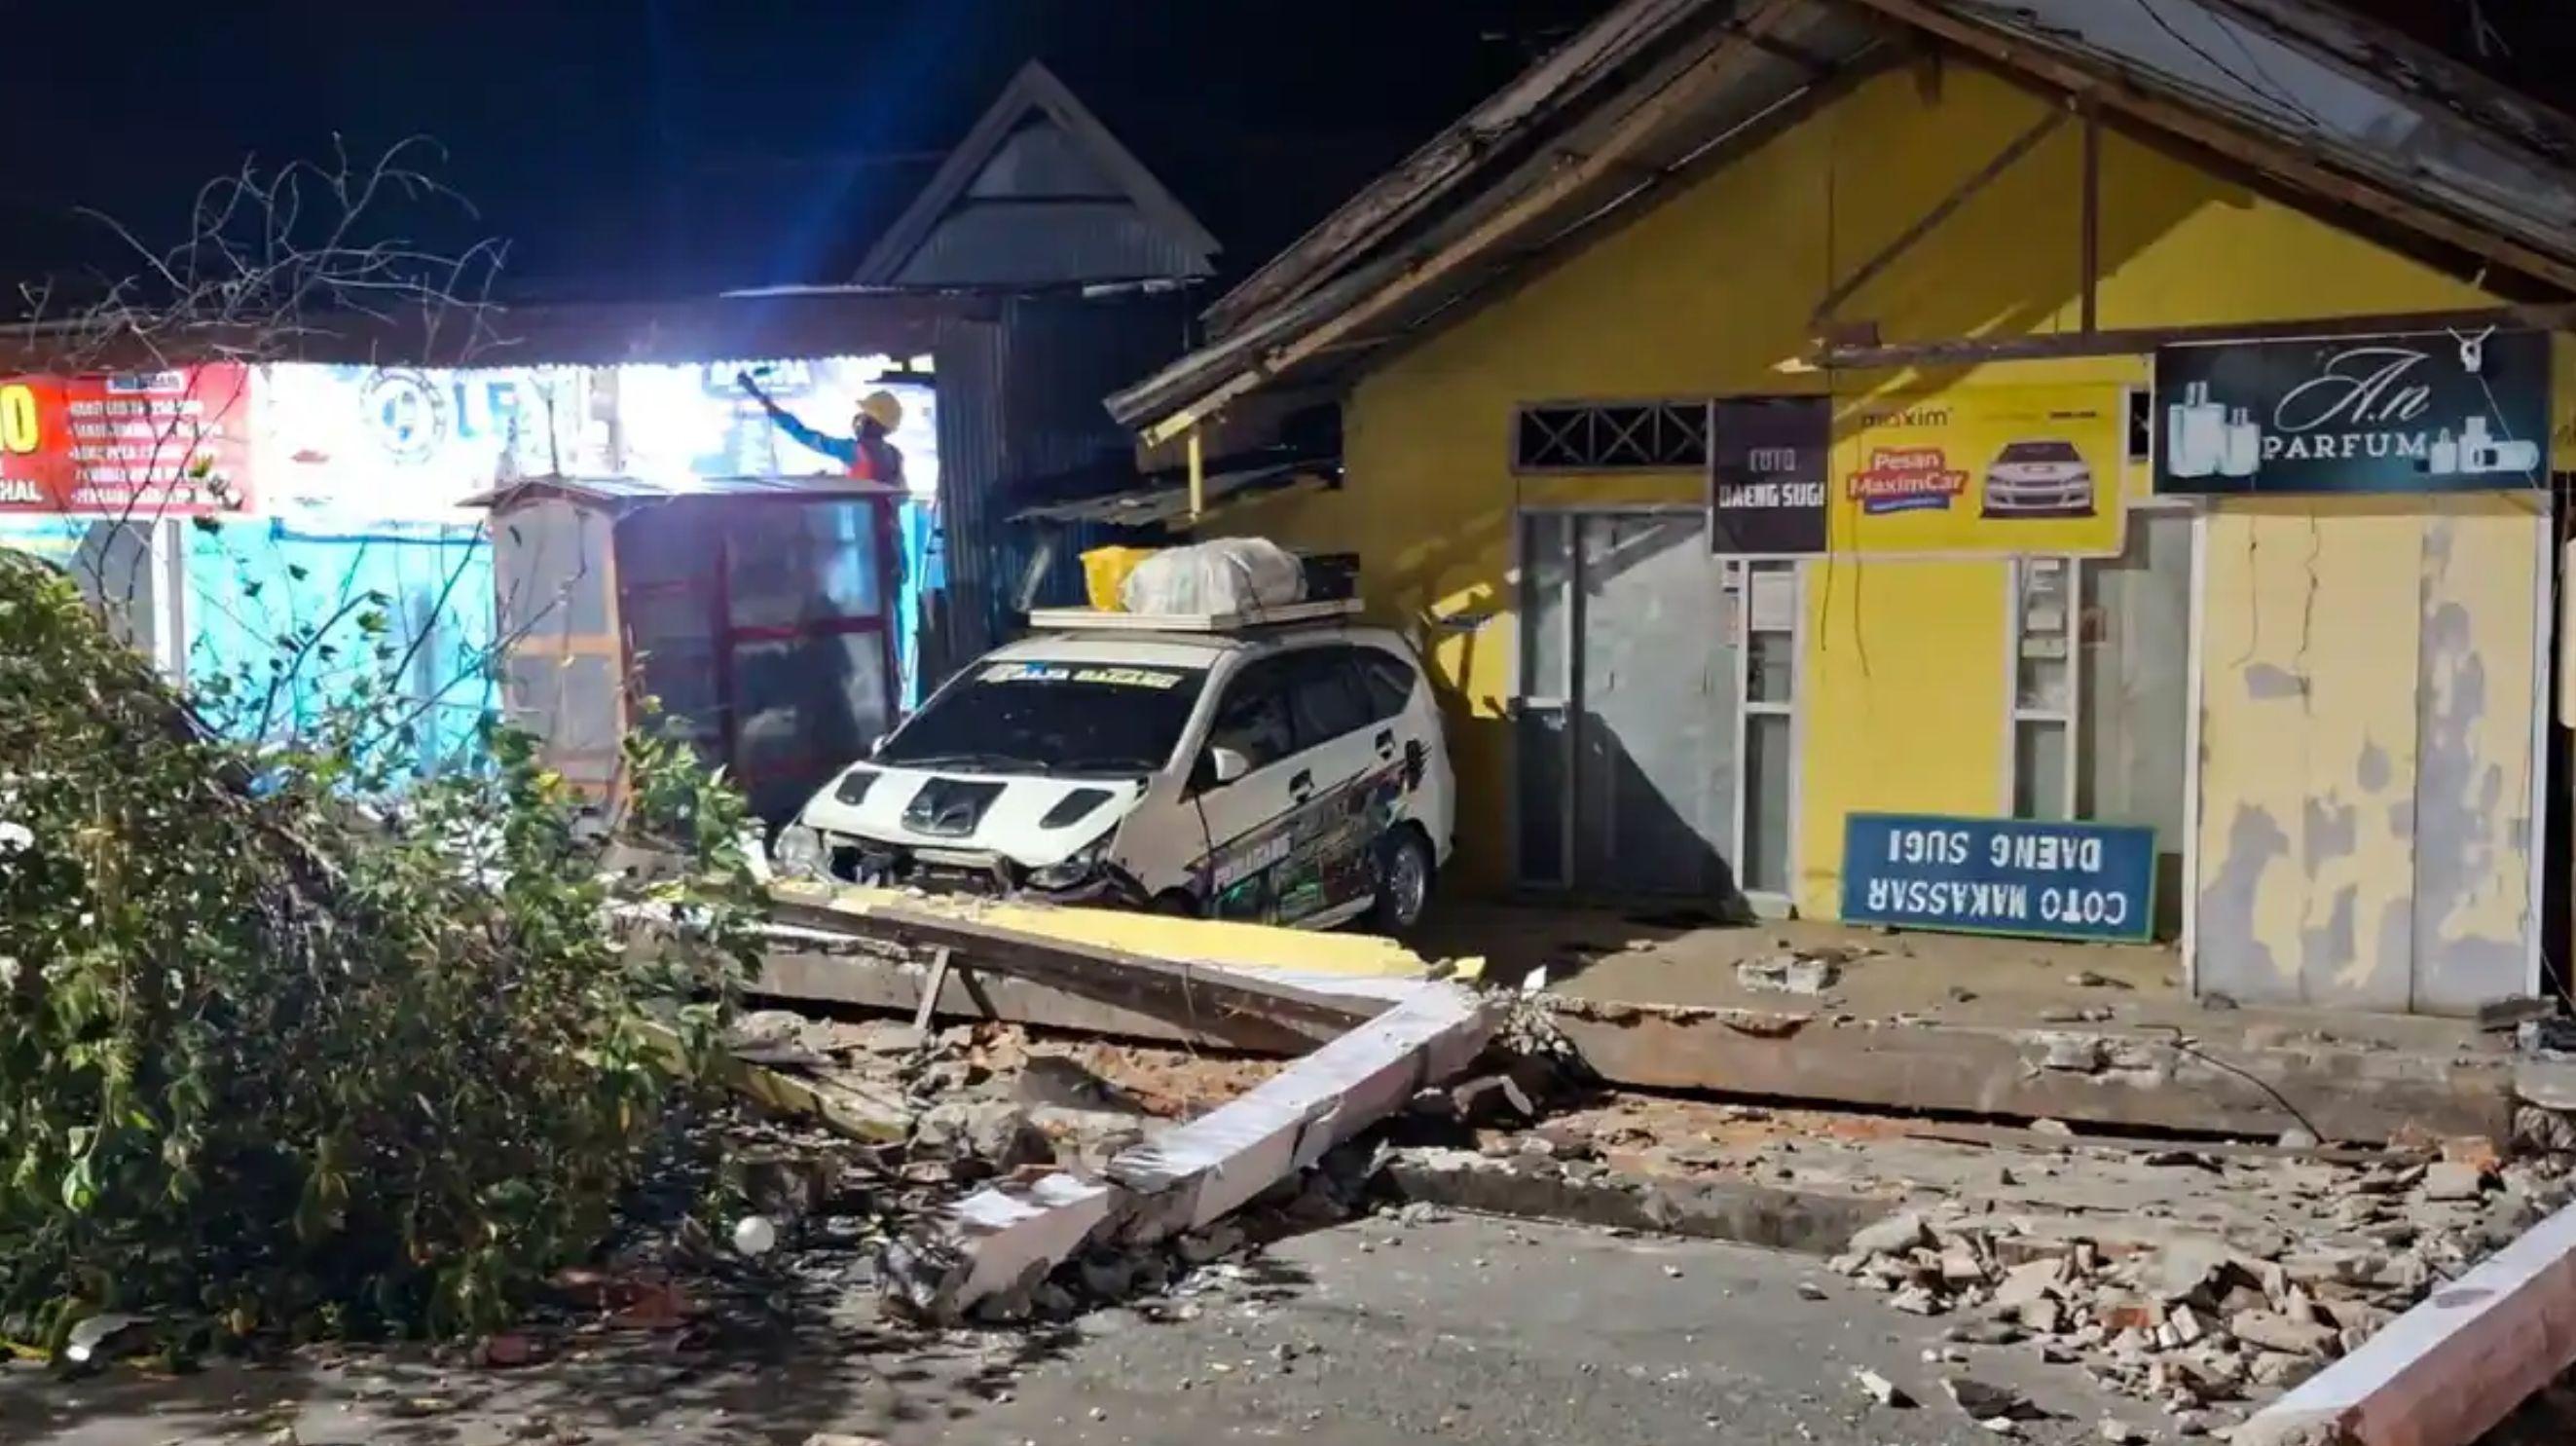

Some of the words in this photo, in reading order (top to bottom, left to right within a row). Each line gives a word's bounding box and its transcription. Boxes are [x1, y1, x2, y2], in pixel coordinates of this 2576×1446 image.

[1860, 408, 1948, 427] maxim
[2263, 432, 2429, 461] PARFUM
[1873, 452, 1940, 471] Pesan
[1719, 483, 1779, 507] DAENG
[1782, 482, 1825, 507] SUGI
[1850, 471, 1965, 498] MaximCar
[1888, 829, 1969, 865] SUGI
[1990, 834, 2103, 872] DAENG
[1867, 877, 2028, 920] MAKASSAR
[2041, 887, 2128, 926] COTO
